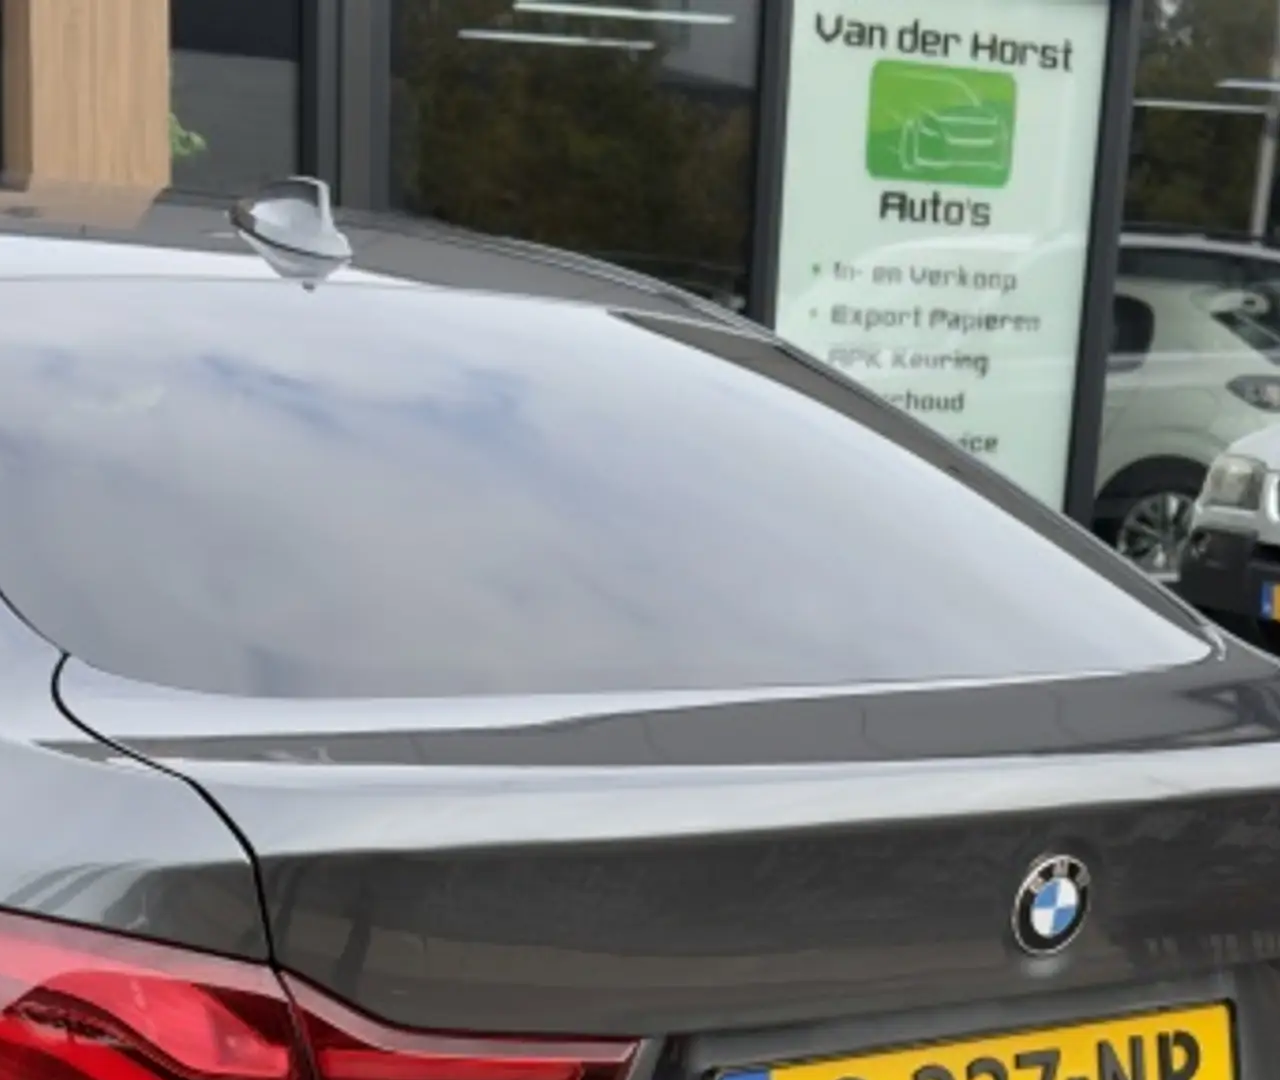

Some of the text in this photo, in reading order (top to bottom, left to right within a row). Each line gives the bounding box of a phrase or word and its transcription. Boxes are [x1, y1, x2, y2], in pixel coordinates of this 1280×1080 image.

[815, 13, 1074, 72] Van der Horst
[878, 190, 991, 228] Auto's
[872, 265, 903, 286] en
[909, 264, 1018, 295] Verkoop
[830, 304, 1041, 336] Export Papieren
[827, 348, 989, 378] APK Keuring
